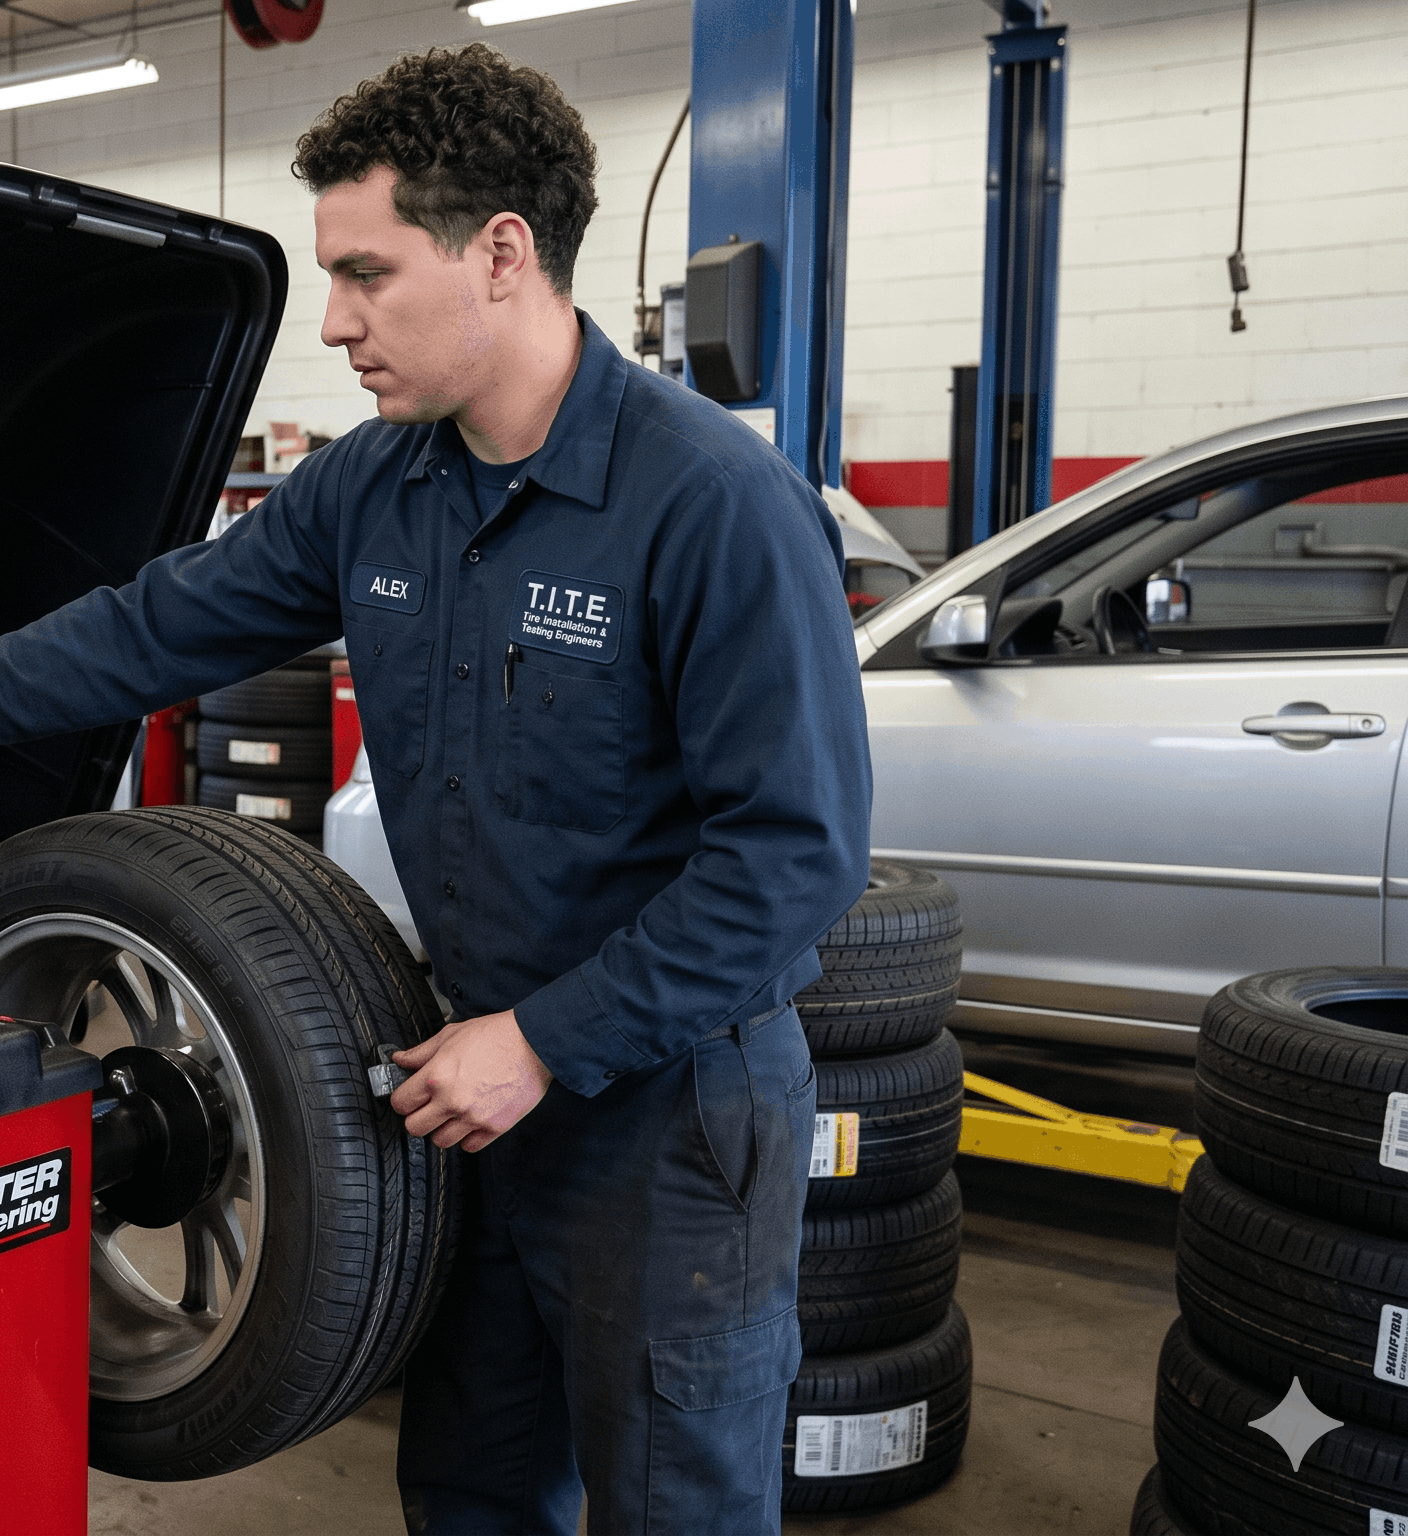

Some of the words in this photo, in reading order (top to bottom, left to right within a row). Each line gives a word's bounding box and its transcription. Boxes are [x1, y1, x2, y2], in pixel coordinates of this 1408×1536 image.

[369, 576, 409, 600] ALEX
[528, 582, 611, 624] T.I.T.E.
[522, 622, 553, 640] Testing
[523, 611, 541, 623] Tire
[599, 627, 607, 637] &
